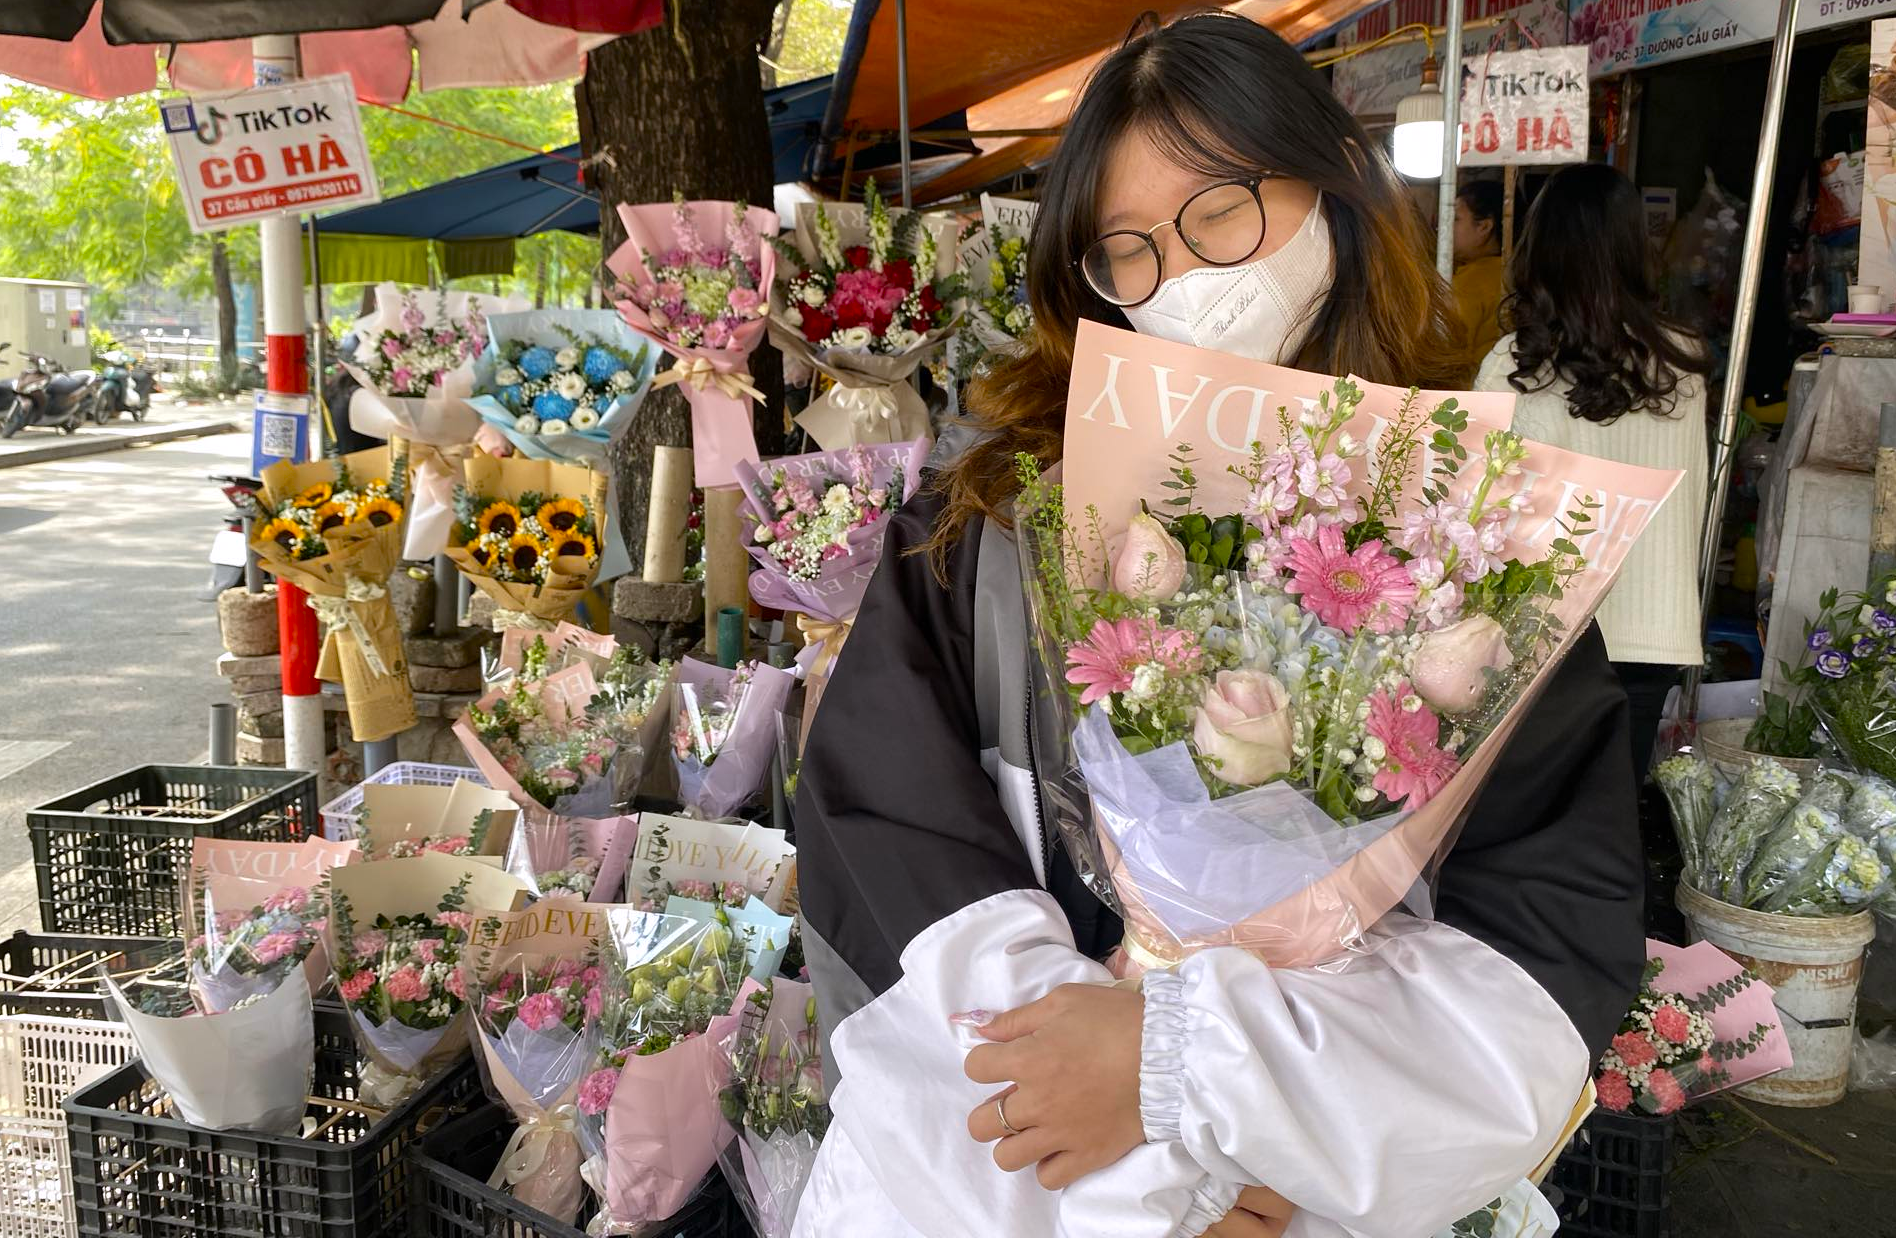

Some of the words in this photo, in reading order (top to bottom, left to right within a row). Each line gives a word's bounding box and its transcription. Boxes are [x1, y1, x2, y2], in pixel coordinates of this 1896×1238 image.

[1485, 69, 1583, 98] TikTok
[235, 102, 332, 134] TikTok
[199, 145, 267, 190] CÔ
[281, 133, 349, 177] HÀ
[207, 201, 222, 216] 37
